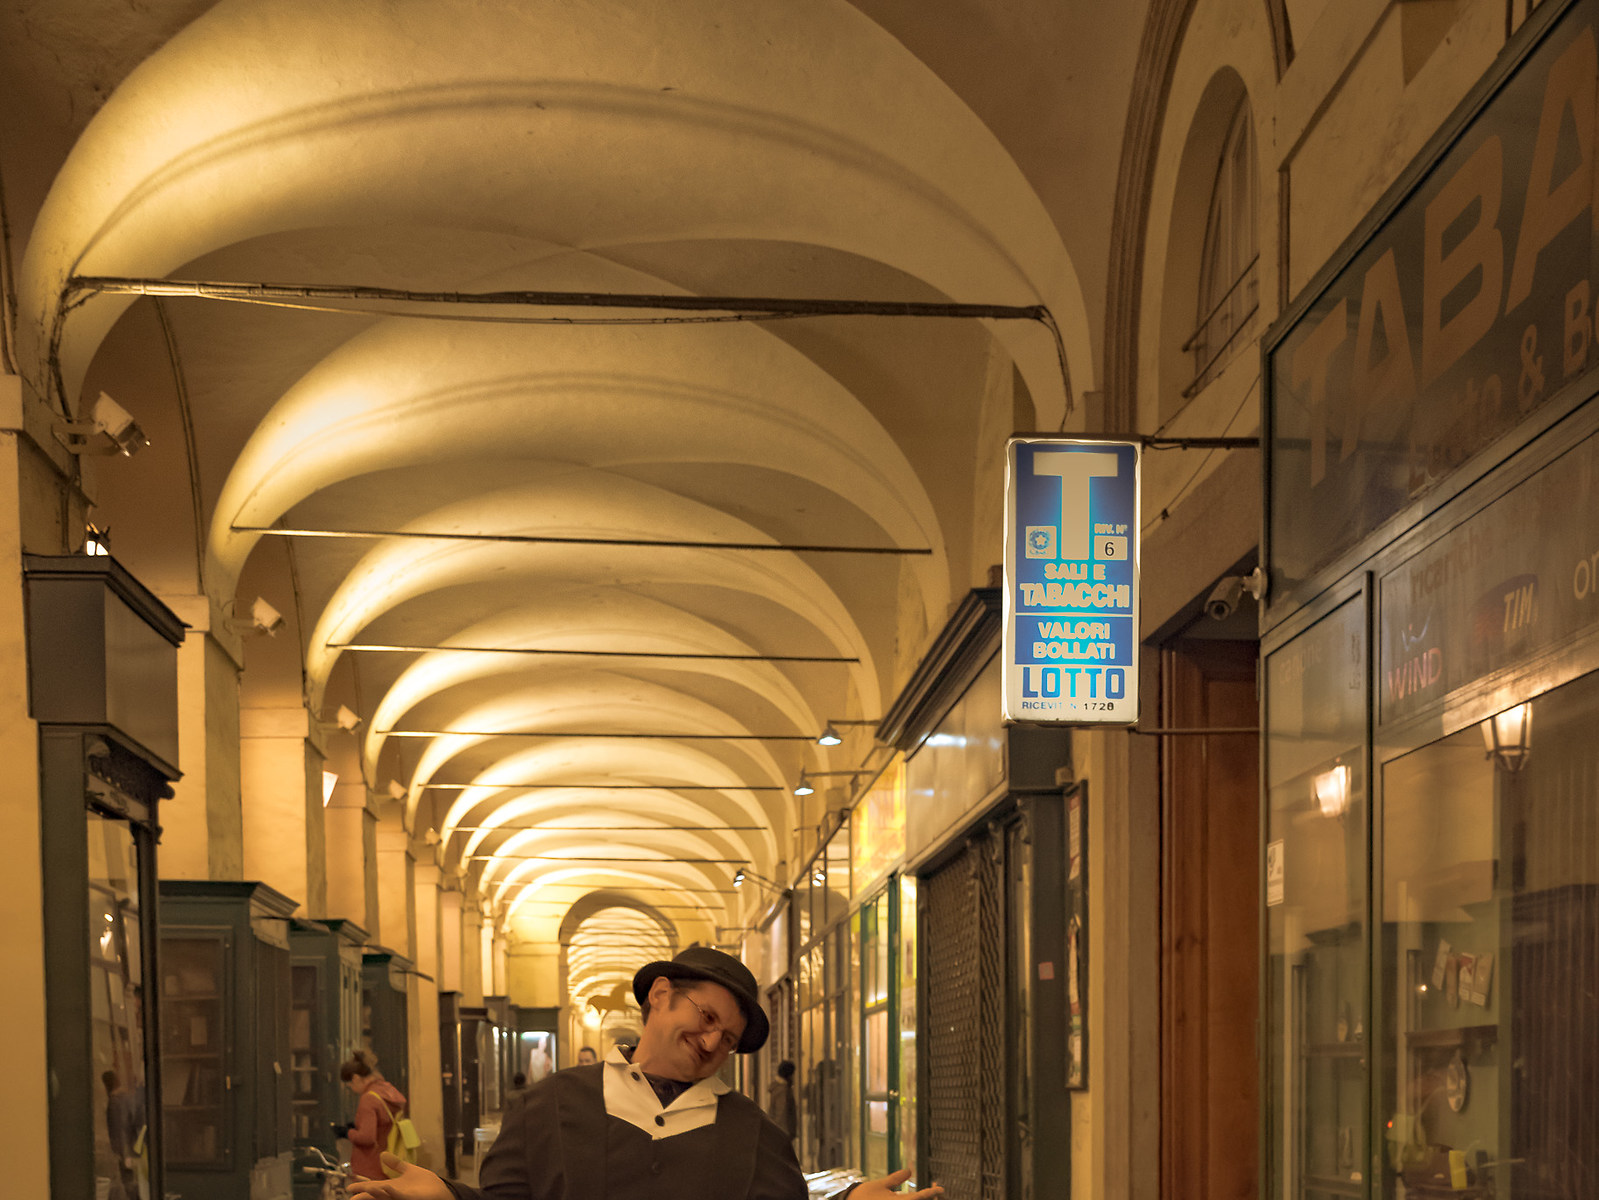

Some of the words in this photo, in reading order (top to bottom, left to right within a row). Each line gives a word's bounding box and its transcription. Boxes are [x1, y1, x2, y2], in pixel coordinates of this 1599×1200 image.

[1033, 451, 1118, 560] T
[1104, 541, 1115, 557] 6
[1044, 563, 1088, 581] SALI
[1093, 564, 1106, 581] E
[1020, 583, 1130, 608] TABACCHI
[1503, 583, 1535, 633] TIM
[1038, 622, 1110, 640] VALORI
[1033, 642, 1116, 660] BOLLATI
[1022, 666, 1126, 700] LOTTO
[1388, 647, 1443, 701] WIND
